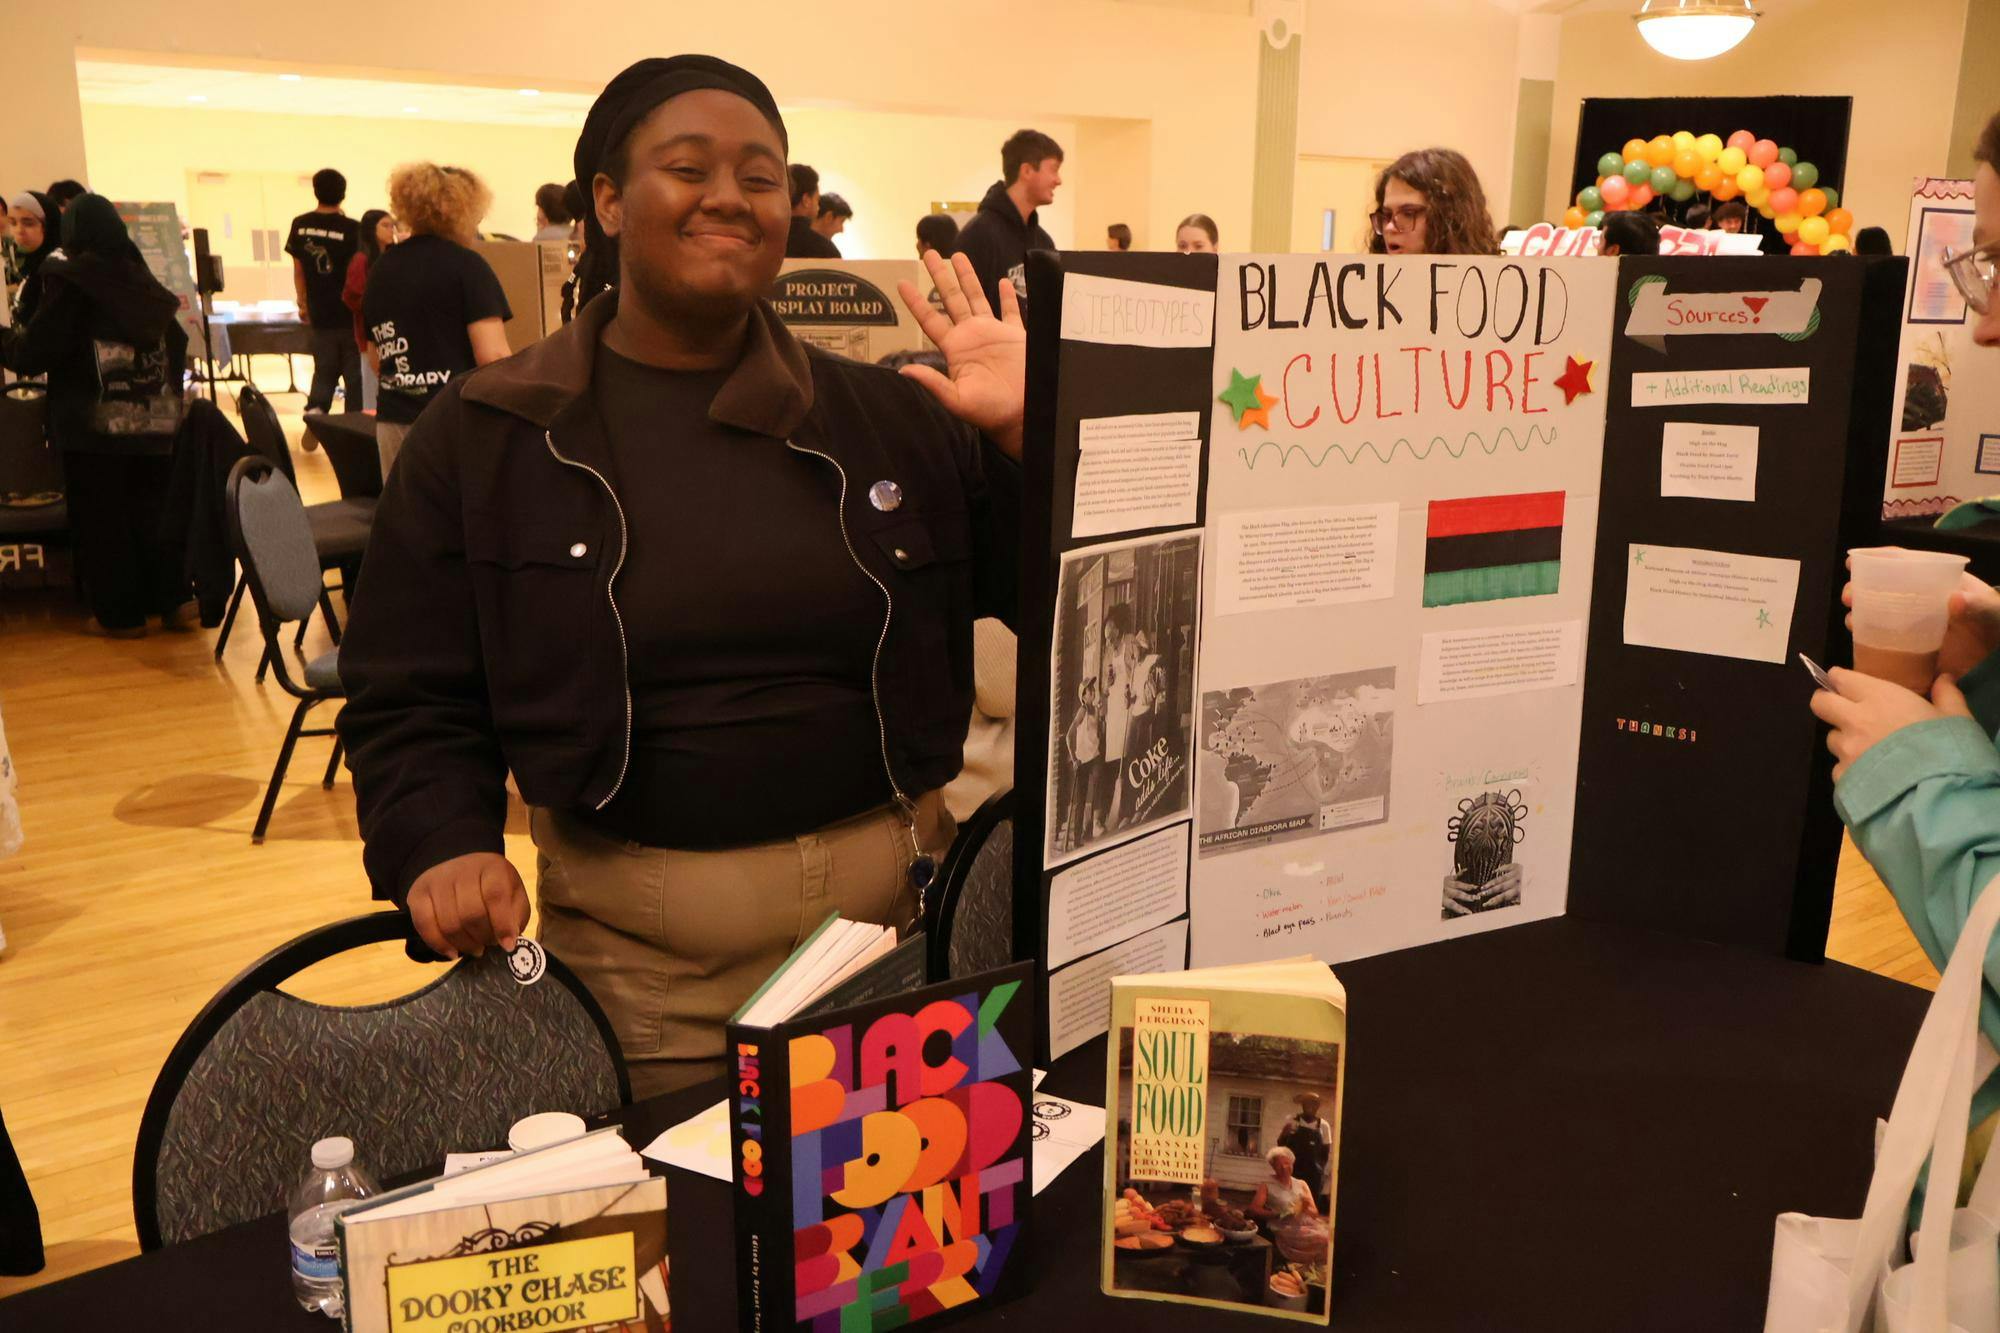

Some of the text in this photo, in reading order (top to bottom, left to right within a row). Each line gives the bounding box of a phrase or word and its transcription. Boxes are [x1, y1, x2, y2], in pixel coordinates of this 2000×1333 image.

[786, 282, 857, 297] PROJECT
[772, 300, 882, 316] ISPLAY BOARD
[1071, 287, 1204, 337] STEREOTYPES
[1238, 262, 1568, 346] BLACK FOOD
[372, 321, 396, 343] THIS
[377, 337, 409, 360] ORLD
[395, 356, 410, 373] IS
[1283, 347, 1549, 429] CULTURE
[1739, 375, 1807, 399] Readings
[1616, 718, 1697, 742] THANKS!
[1128, 737, 1168, 789] Coke
[1200, 836, 1213, 845] THE
[1214, 830, 1249, 842] AFRICAN
[1250, 822, 1288, 836] DIASPORA
[1139, 1016, 1205, 1026] FERGUSON
[1151, 1005, 1193, 1015] SHEILA
[788, 980, 1023, 1137] BLACK
[1138, 1028, 1203, 1084] SOUL
[1136, 1083, 1202, 1138] FOOD
[791, 1081, 1024, 1232] FOOD
[1134, 1139, 1200, 1150] CLASSIC
[1134, 1150, 1199, 1160] CUISINE
[1134, 1158, 1198, 1170] FROM THE
[1134, 1168, 1200, 1180] DEEP SOUTH
[487, 1253, 540, 1278] THE
[400, 1266, 627, 1323] DOOKY CHASE
[447, 1301, 587, 1333] COOKBOOK
